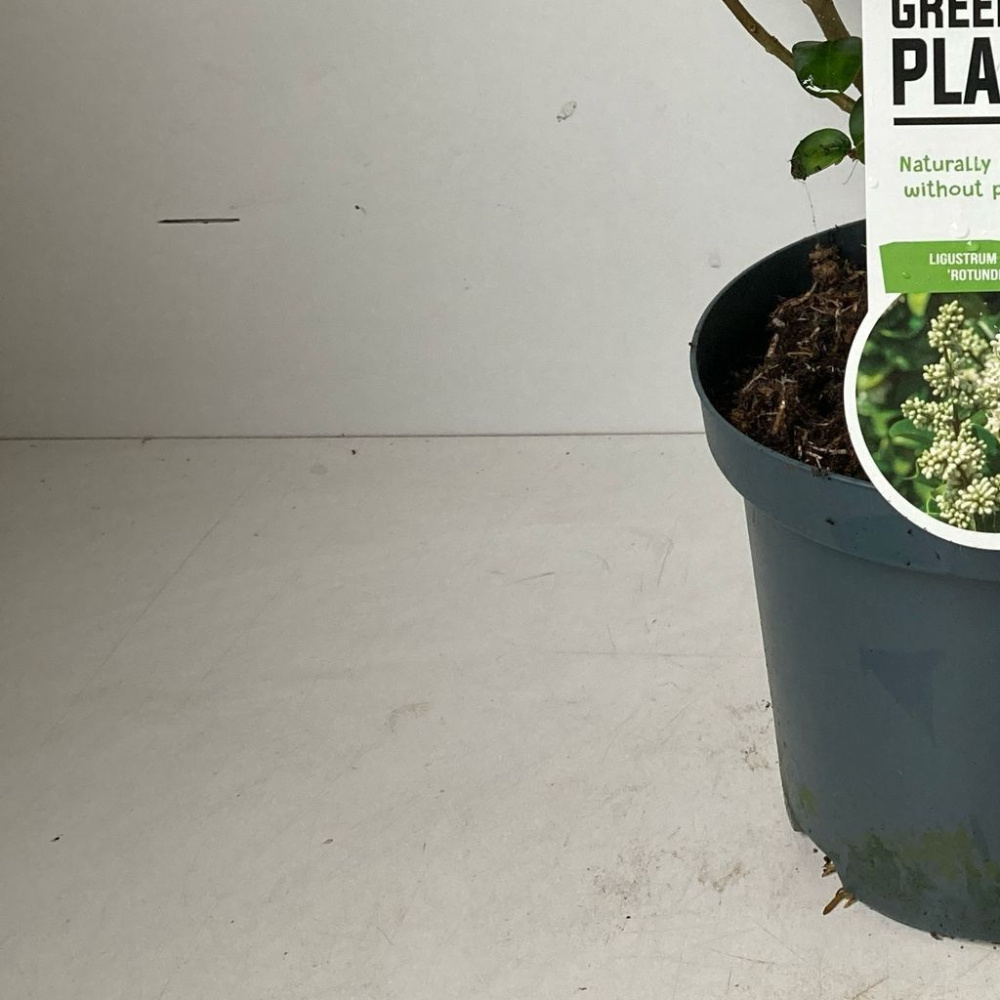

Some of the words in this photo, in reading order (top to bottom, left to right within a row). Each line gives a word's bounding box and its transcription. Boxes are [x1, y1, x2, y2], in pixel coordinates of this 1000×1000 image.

[899, 155, 991, 174] Naturally
[904, 179, 983, 197] without
[929, 252, 997, 265] LIGUSTRUM
